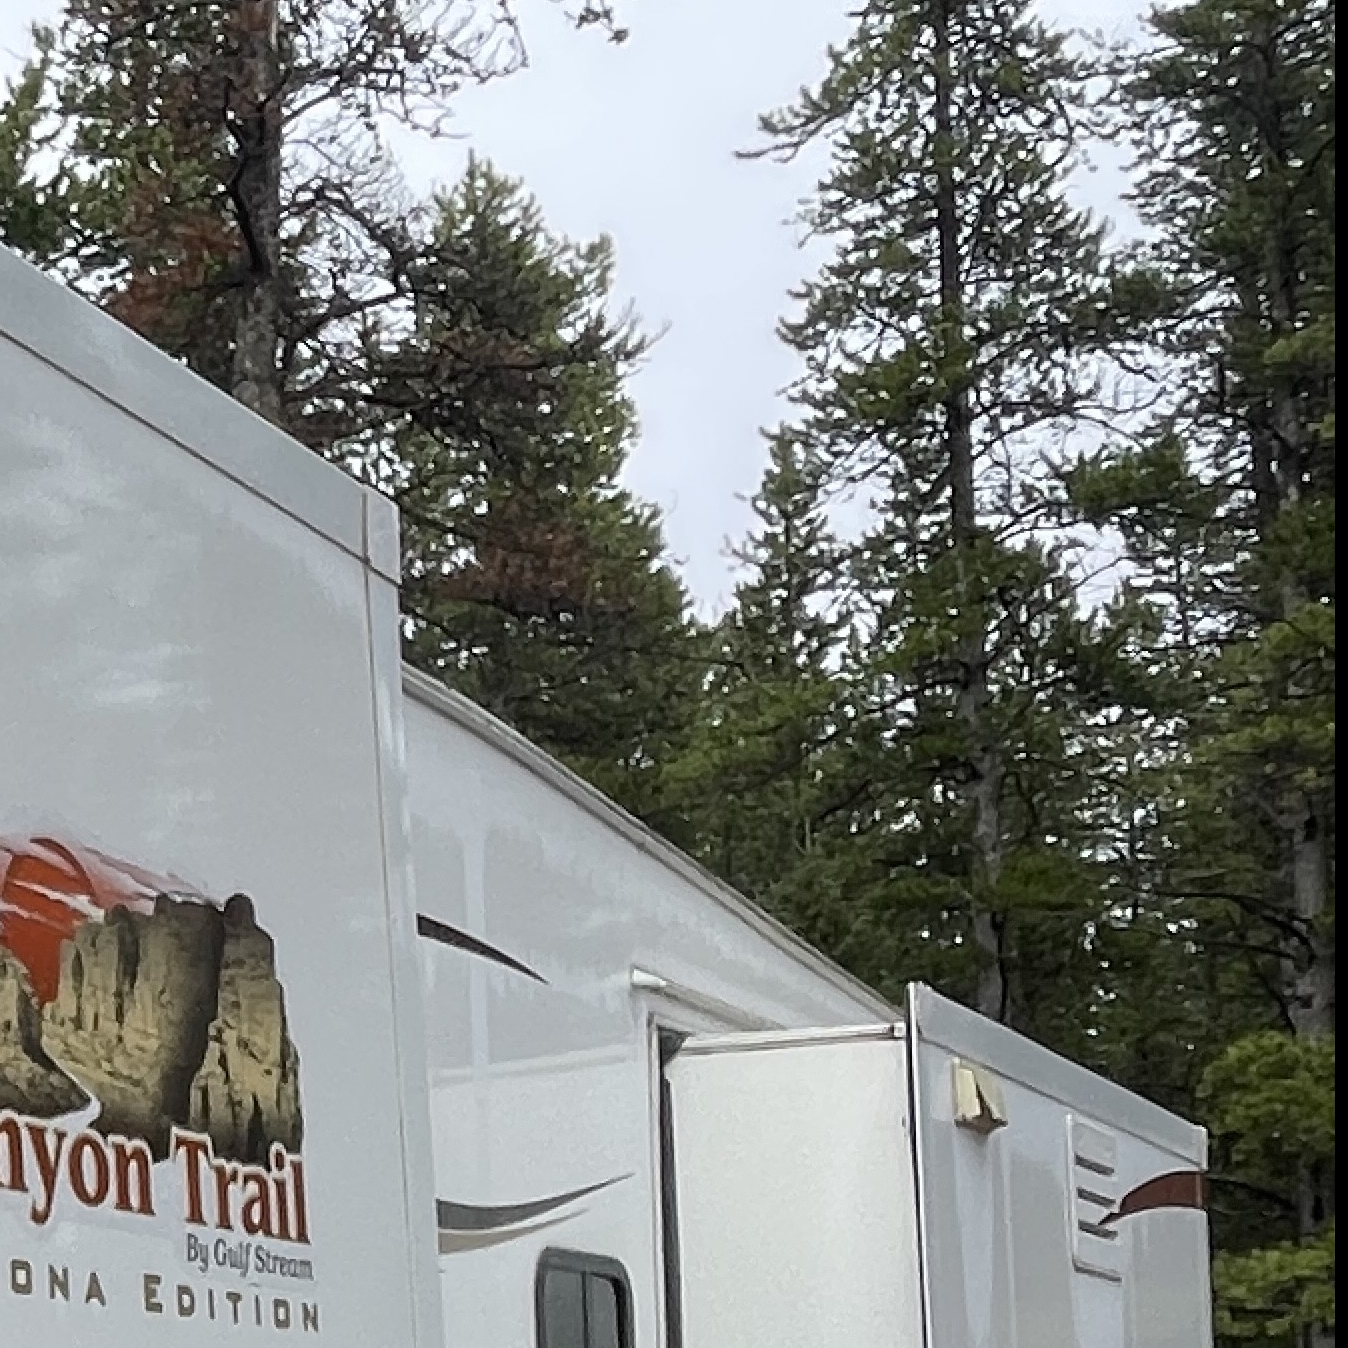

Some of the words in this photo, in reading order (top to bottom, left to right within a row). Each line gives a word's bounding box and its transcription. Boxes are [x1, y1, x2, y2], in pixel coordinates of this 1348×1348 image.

[175, 1136, 311, 1245] Trail
[187, 1232, 209, 1274] By
[213, 1238, 253, 1278] Gulf
[254, 1244, 315, 1281] Stream
[143, 1273, 320, 1334] EDITION
